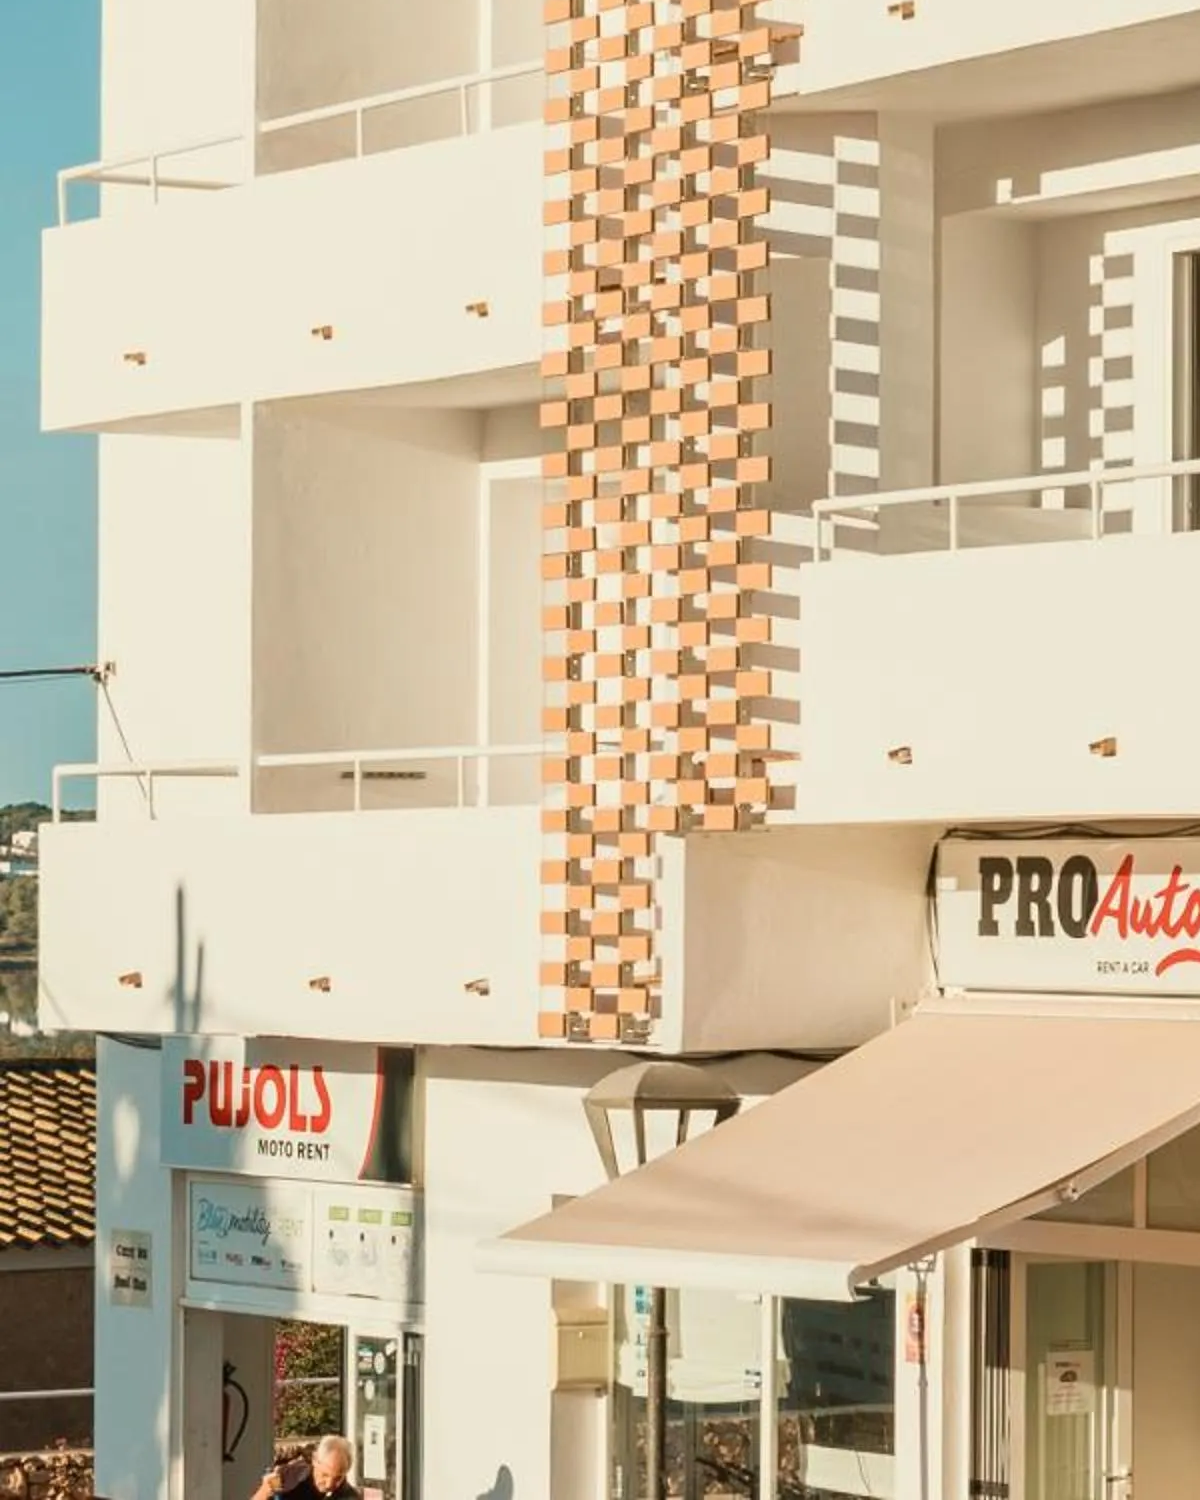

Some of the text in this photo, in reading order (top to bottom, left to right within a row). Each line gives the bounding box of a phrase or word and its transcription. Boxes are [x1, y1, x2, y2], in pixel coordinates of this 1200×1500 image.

[1096, 961, 1150, 975] RENT A CAR
[257, 1139, 331, 1160] MOTO RENT
